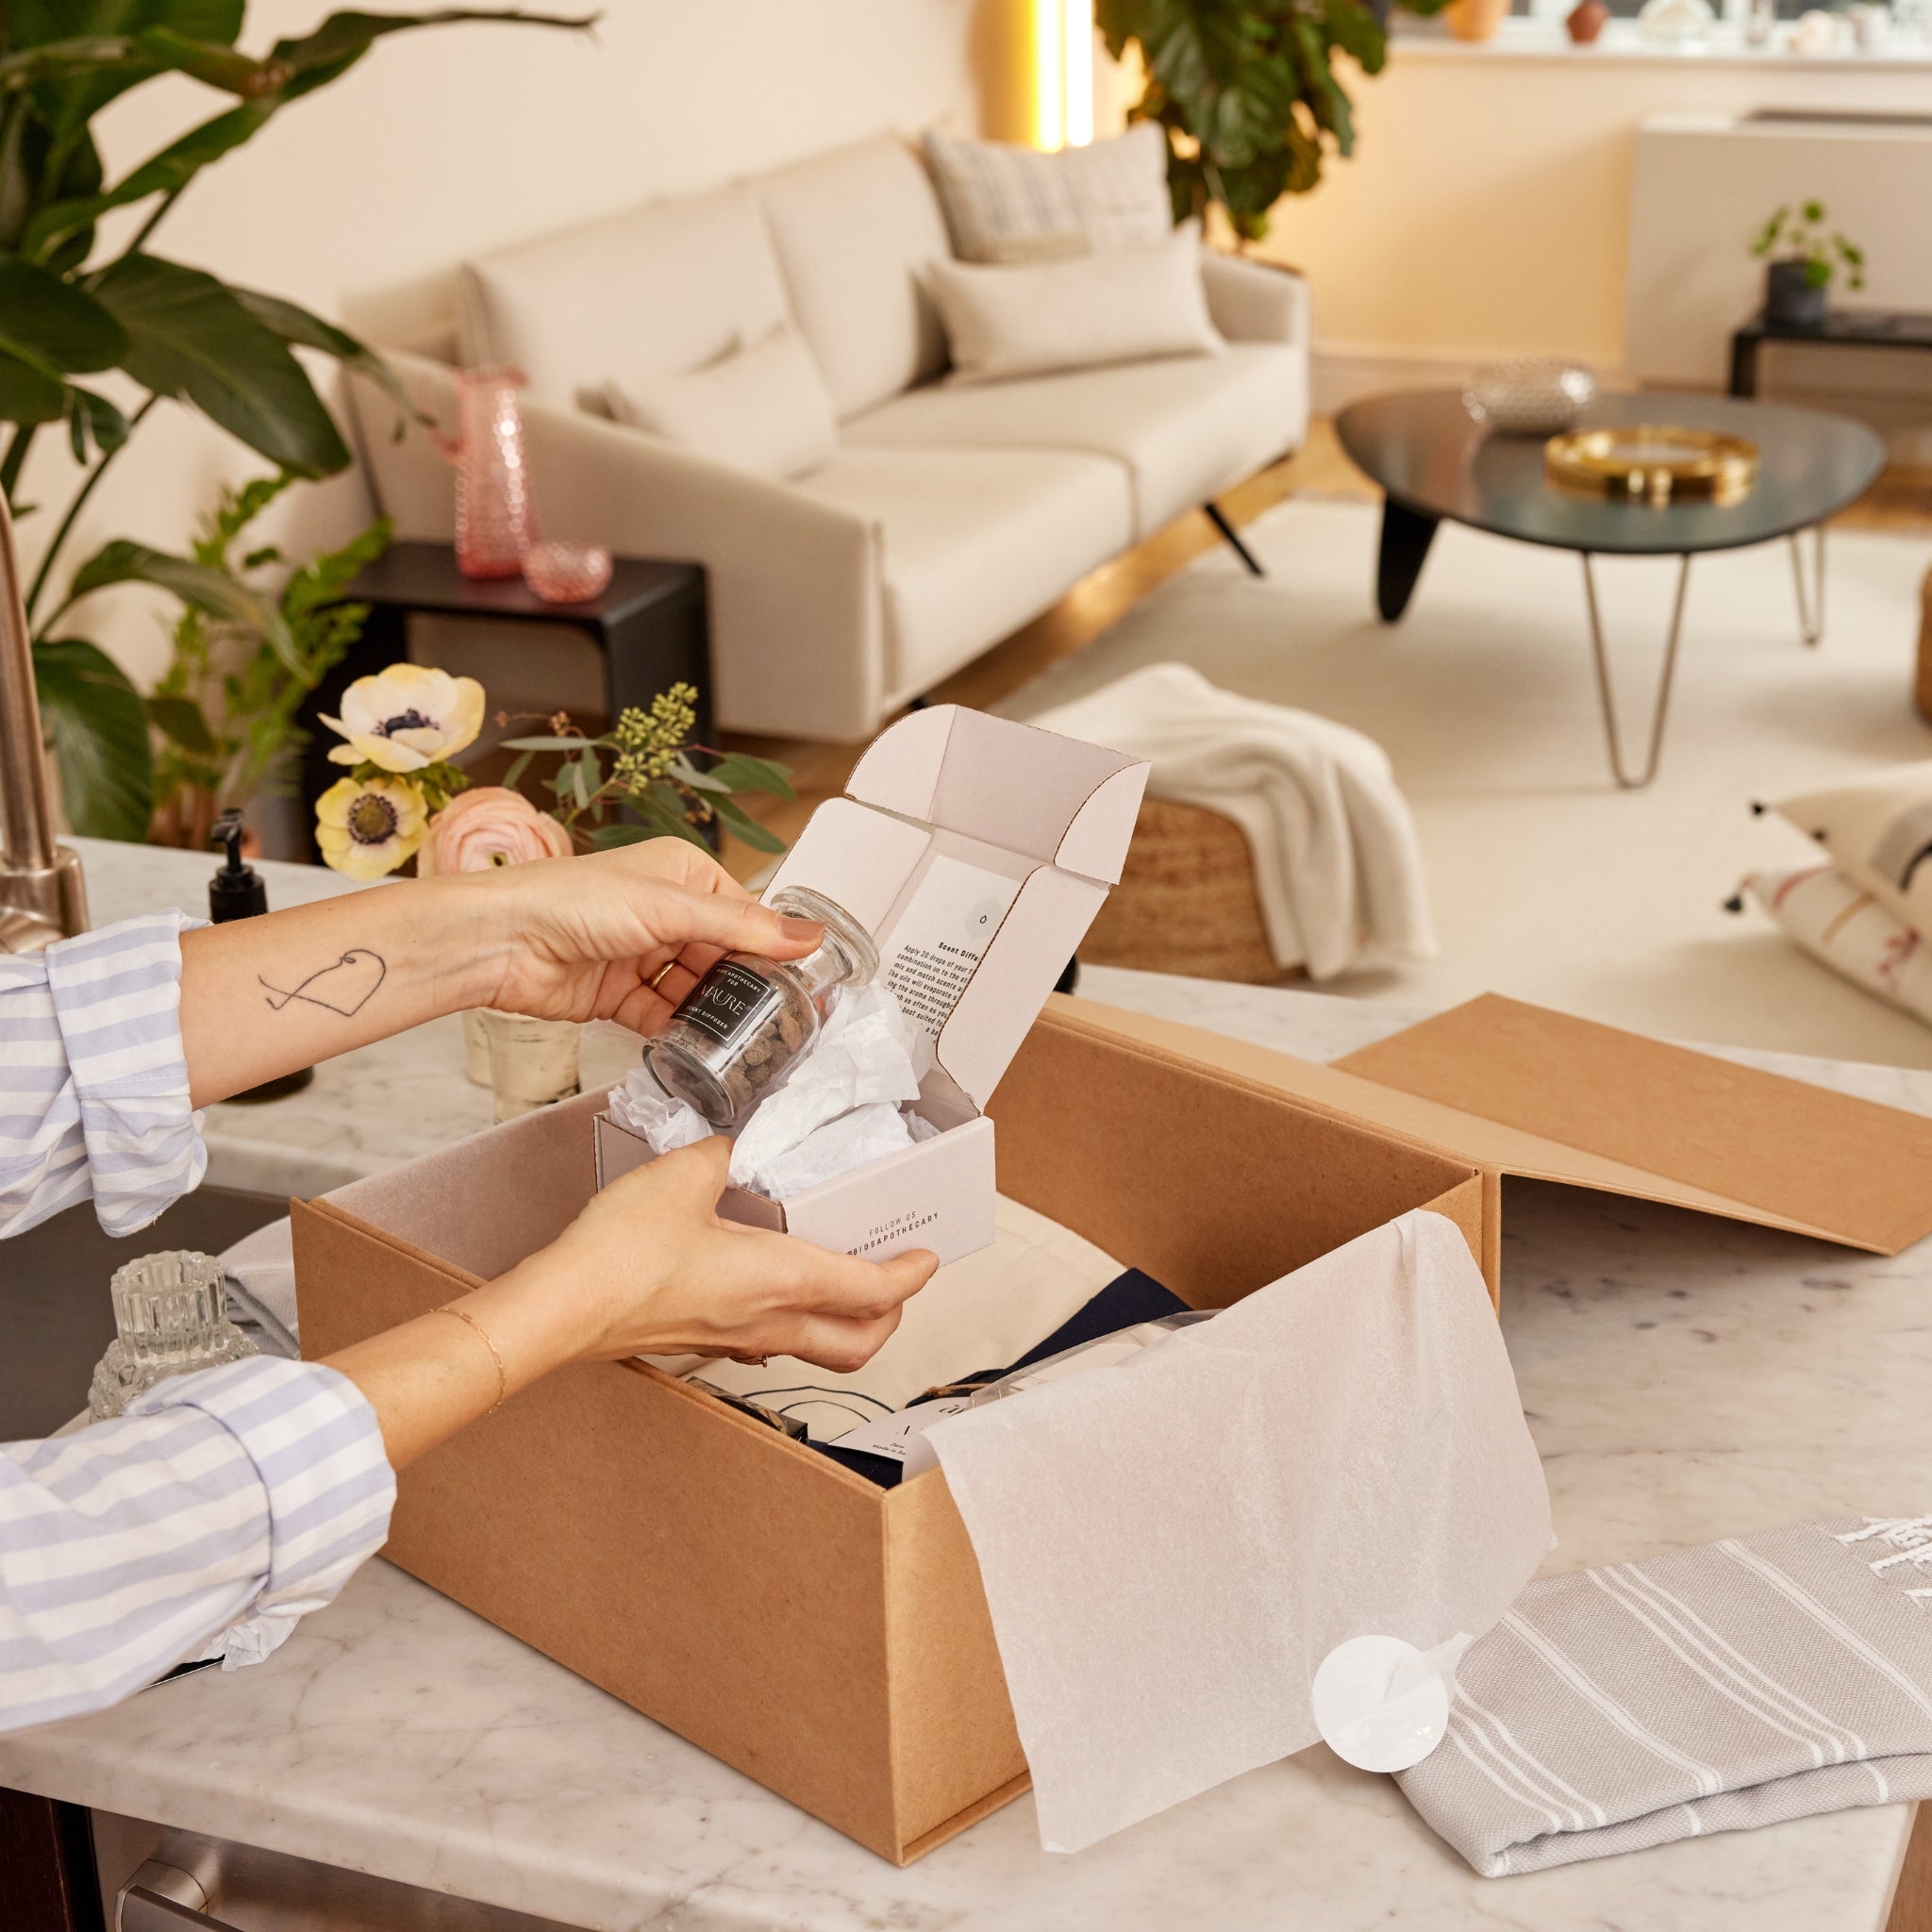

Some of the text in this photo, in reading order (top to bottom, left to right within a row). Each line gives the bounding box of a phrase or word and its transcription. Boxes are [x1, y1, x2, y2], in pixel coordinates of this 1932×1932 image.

[904, 944, 920, 957] Apply
[921, 950, 929, 958] 20
[929, 954, 945, 965] drops
[954, 964, 968, 973] your
[938, 941, 980, 961] Scent Diffu
[893, 962, 905, 971] mix
[905, 966, 918, 974] and
[917, 971, 936, 982] match
[936, 978, 957, 991] scents
[896, 953, 932, 971] combination
[949, 972, 959, 981] the
[726, 978, 739, 987] FOR
[887, 979, 897, 990] ing
[898, 984, 908, 992] the
[888, 969, 899, 978] The
[899, 974, 911, 983] oils
[911, 979, 924, 988] will
[923, 984, 952, 999] evaporate
[698, 983, 746, 1016] MAURE
[912, 1000, 928, 1011] often
[701, 1010, 728, 1030] DIFFUSER
[902, 1006, 916, 1017] best
[916, 1012, 937, 1024] suited
[869, 1210, 916, 1238] FOLLOW US
